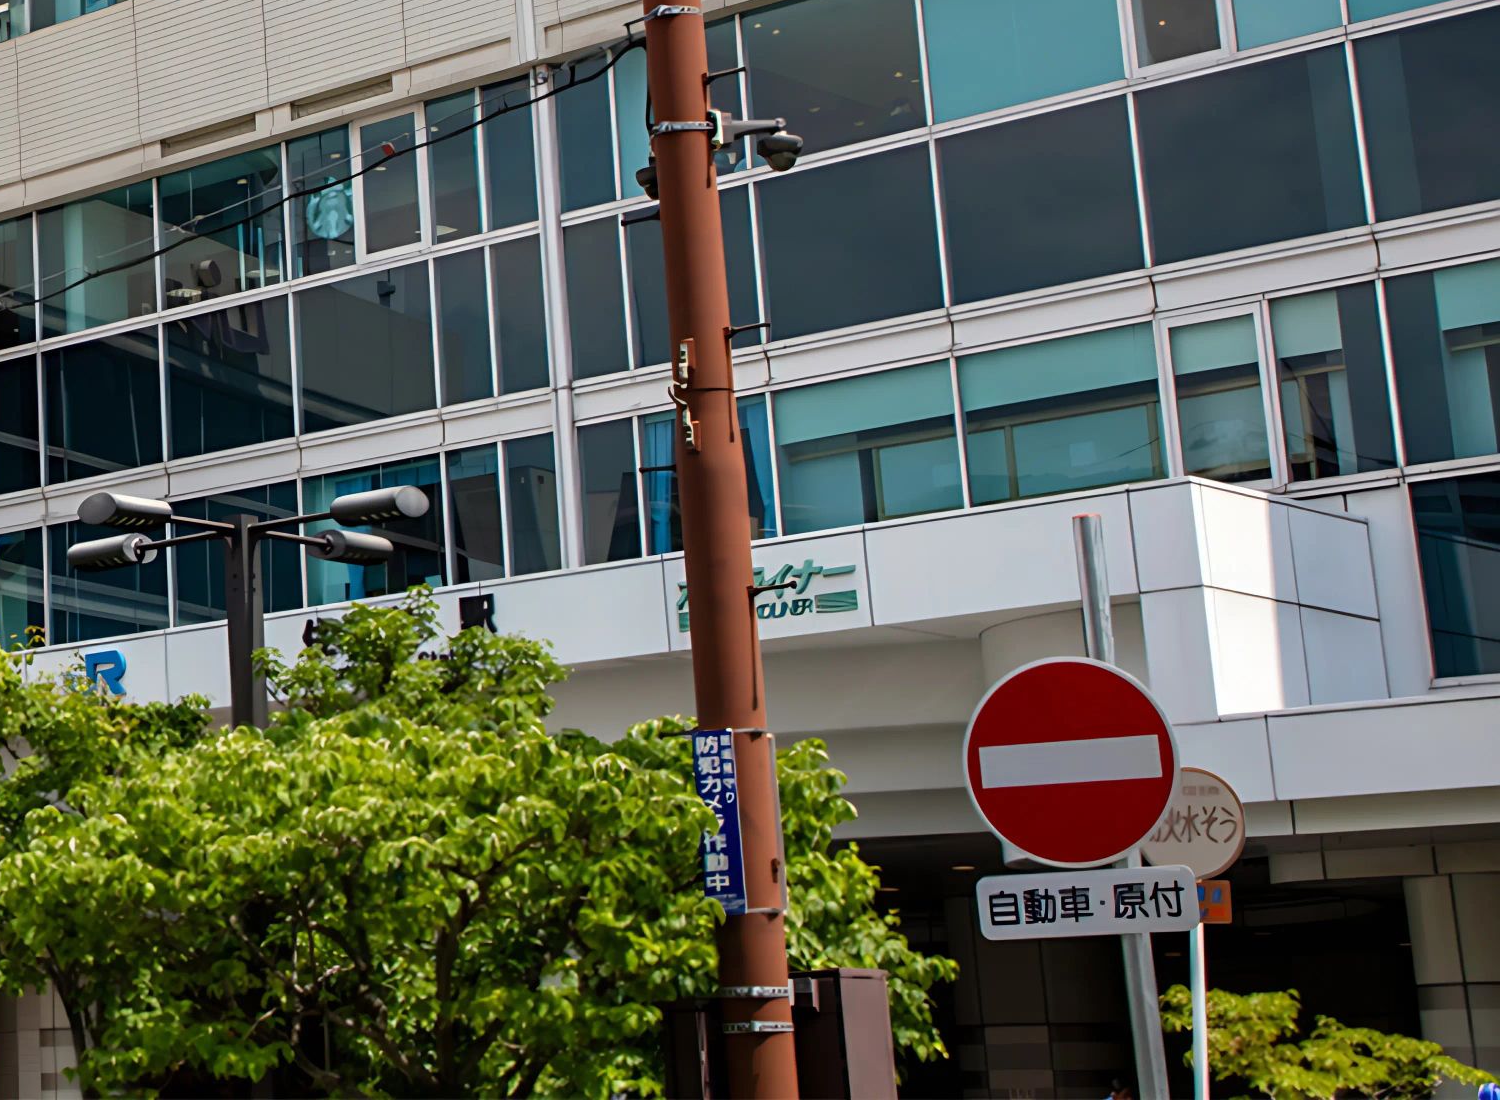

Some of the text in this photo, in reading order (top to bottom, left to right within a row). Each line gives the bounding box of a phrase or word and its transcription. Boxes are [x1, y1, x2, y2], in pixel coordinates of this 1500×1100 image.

[1150, 804, 1238, 844] 火水そう
[988, 880, 1185, 926] 自動車・原付
